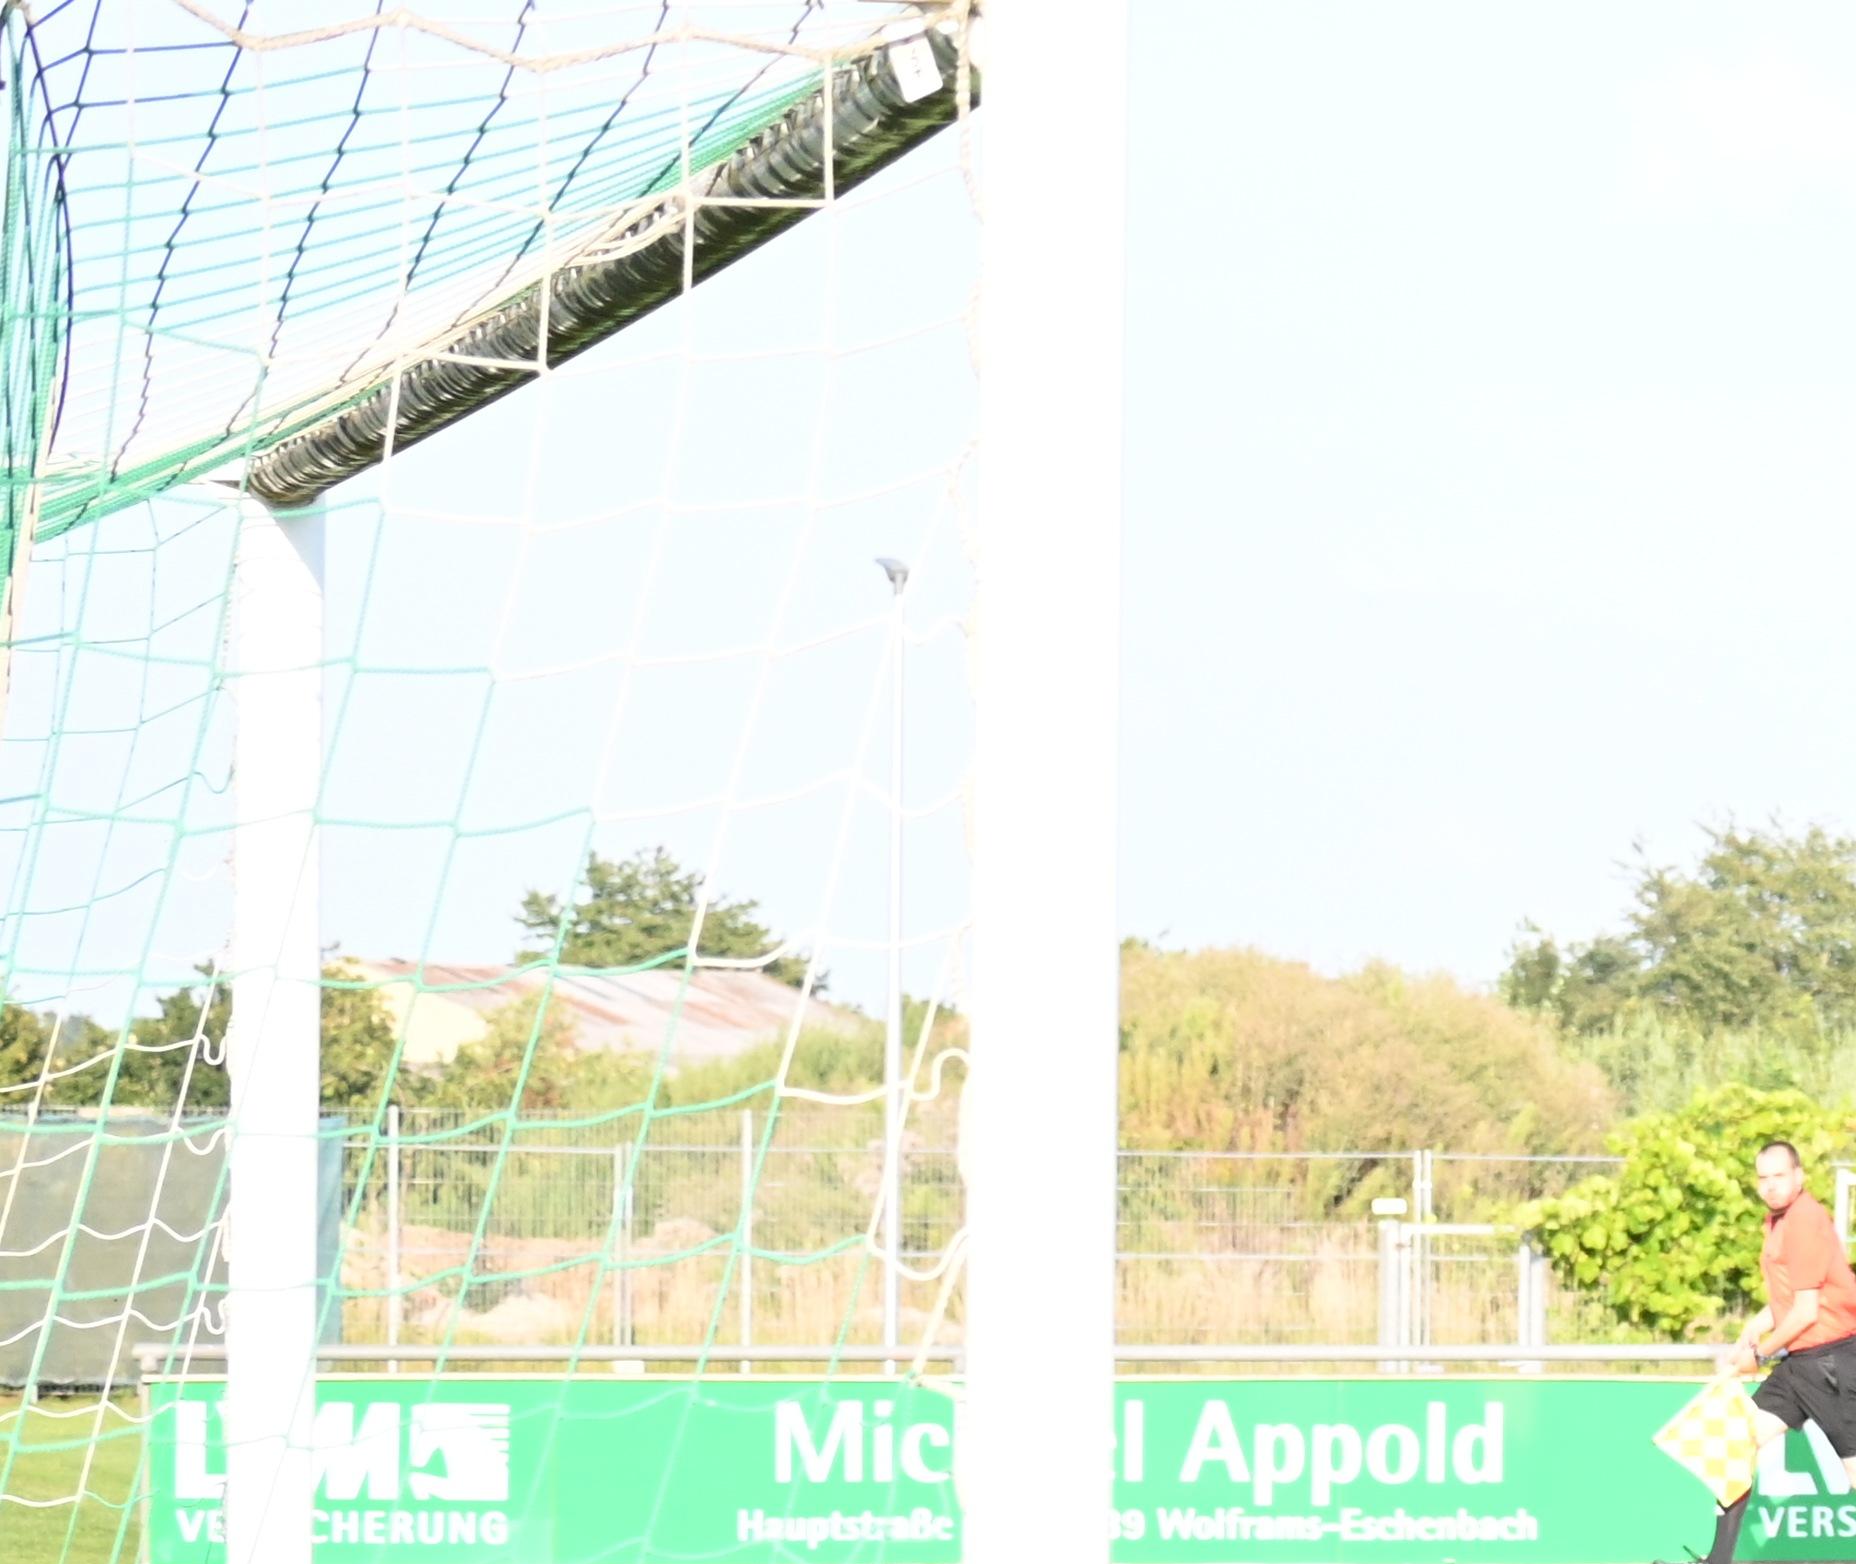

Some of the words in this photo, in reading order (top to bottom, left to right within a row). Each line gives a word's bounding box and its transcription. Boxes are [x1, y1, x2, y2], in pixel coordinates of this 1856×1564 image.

[175, 1400, 400, 1500] LM
[1179, 1399, 1505, 1507] Appold
[736, 1508, 955, 1549] Hauptstraße
[1157, 1508, 1539, 1541] Wolframs-Eschenbach
